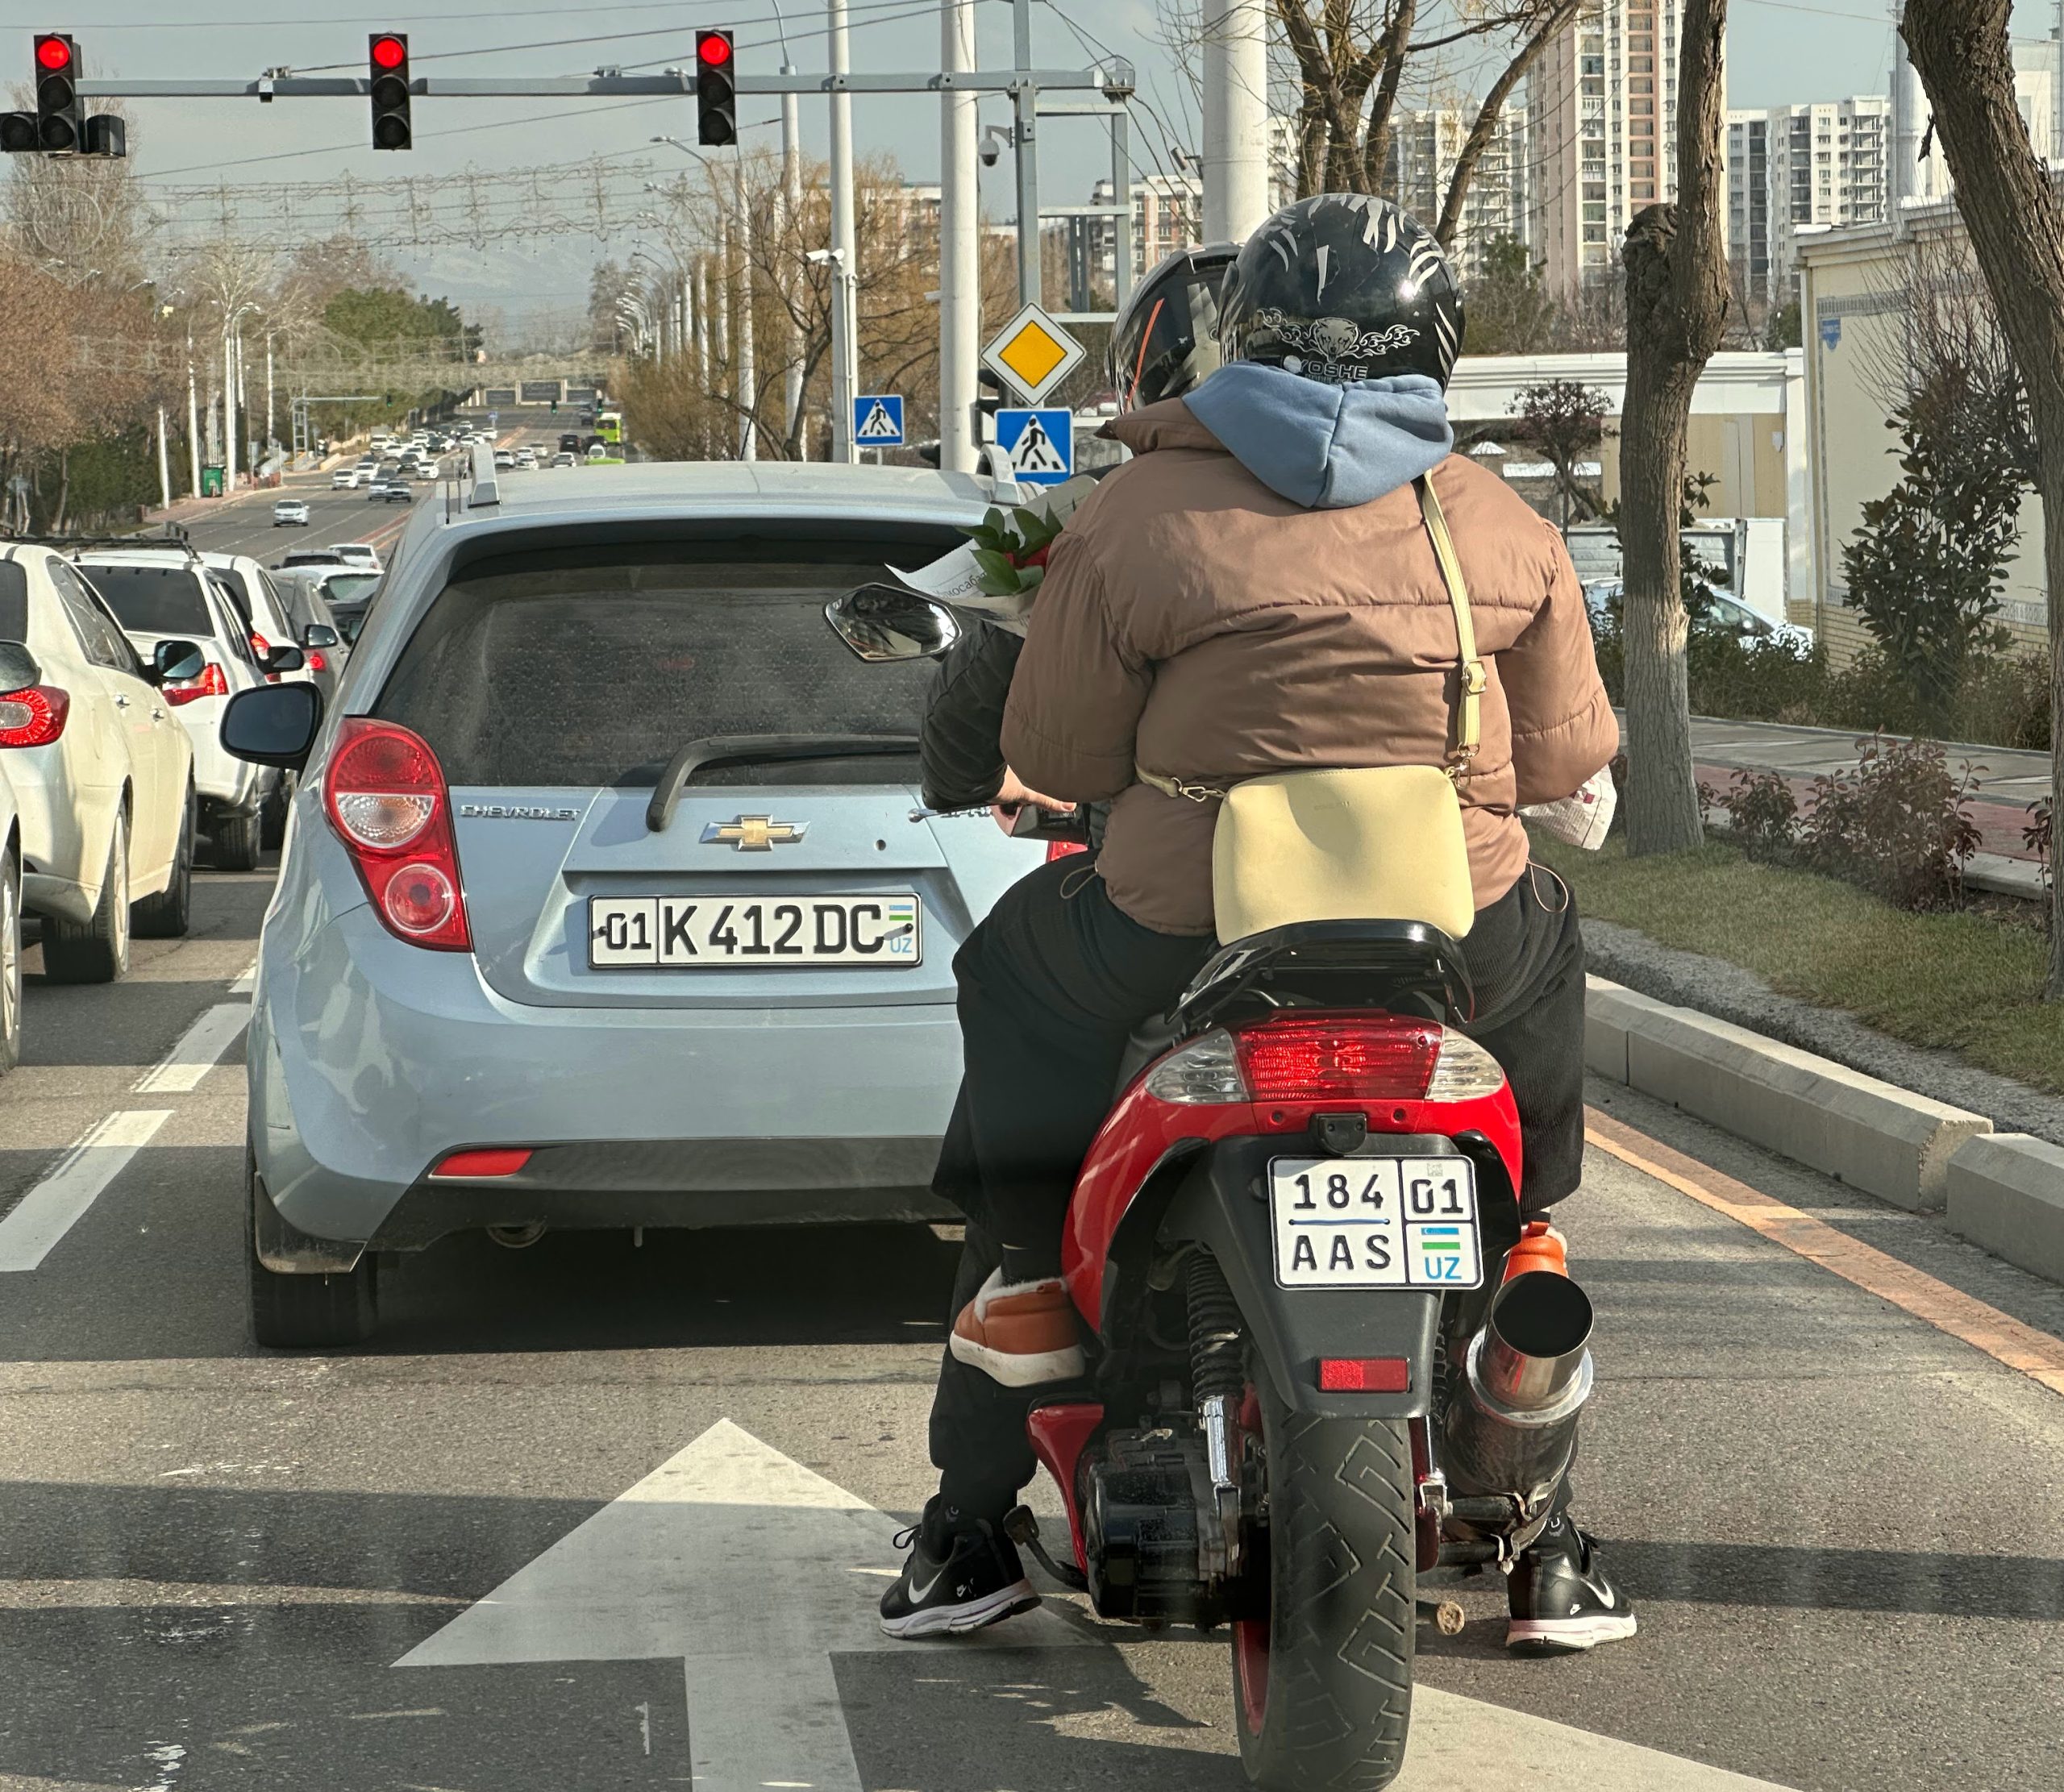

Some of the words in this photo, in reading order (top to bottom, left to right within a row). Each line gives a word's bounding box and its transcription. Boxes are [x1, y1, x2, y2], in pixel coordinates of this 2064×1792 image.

[460, 805, 580, 821] CHEVROLET
[606, 913, 651, 950] 01
[890, 937, 913, 954] UZ
[1293, 1174, 1384, 1210] 184
[1411, 1179, 1463, 1214] 01
[1292, 1234, 1391, 1270] AAS
[1424, 1257, 1463, 1279] UZ
